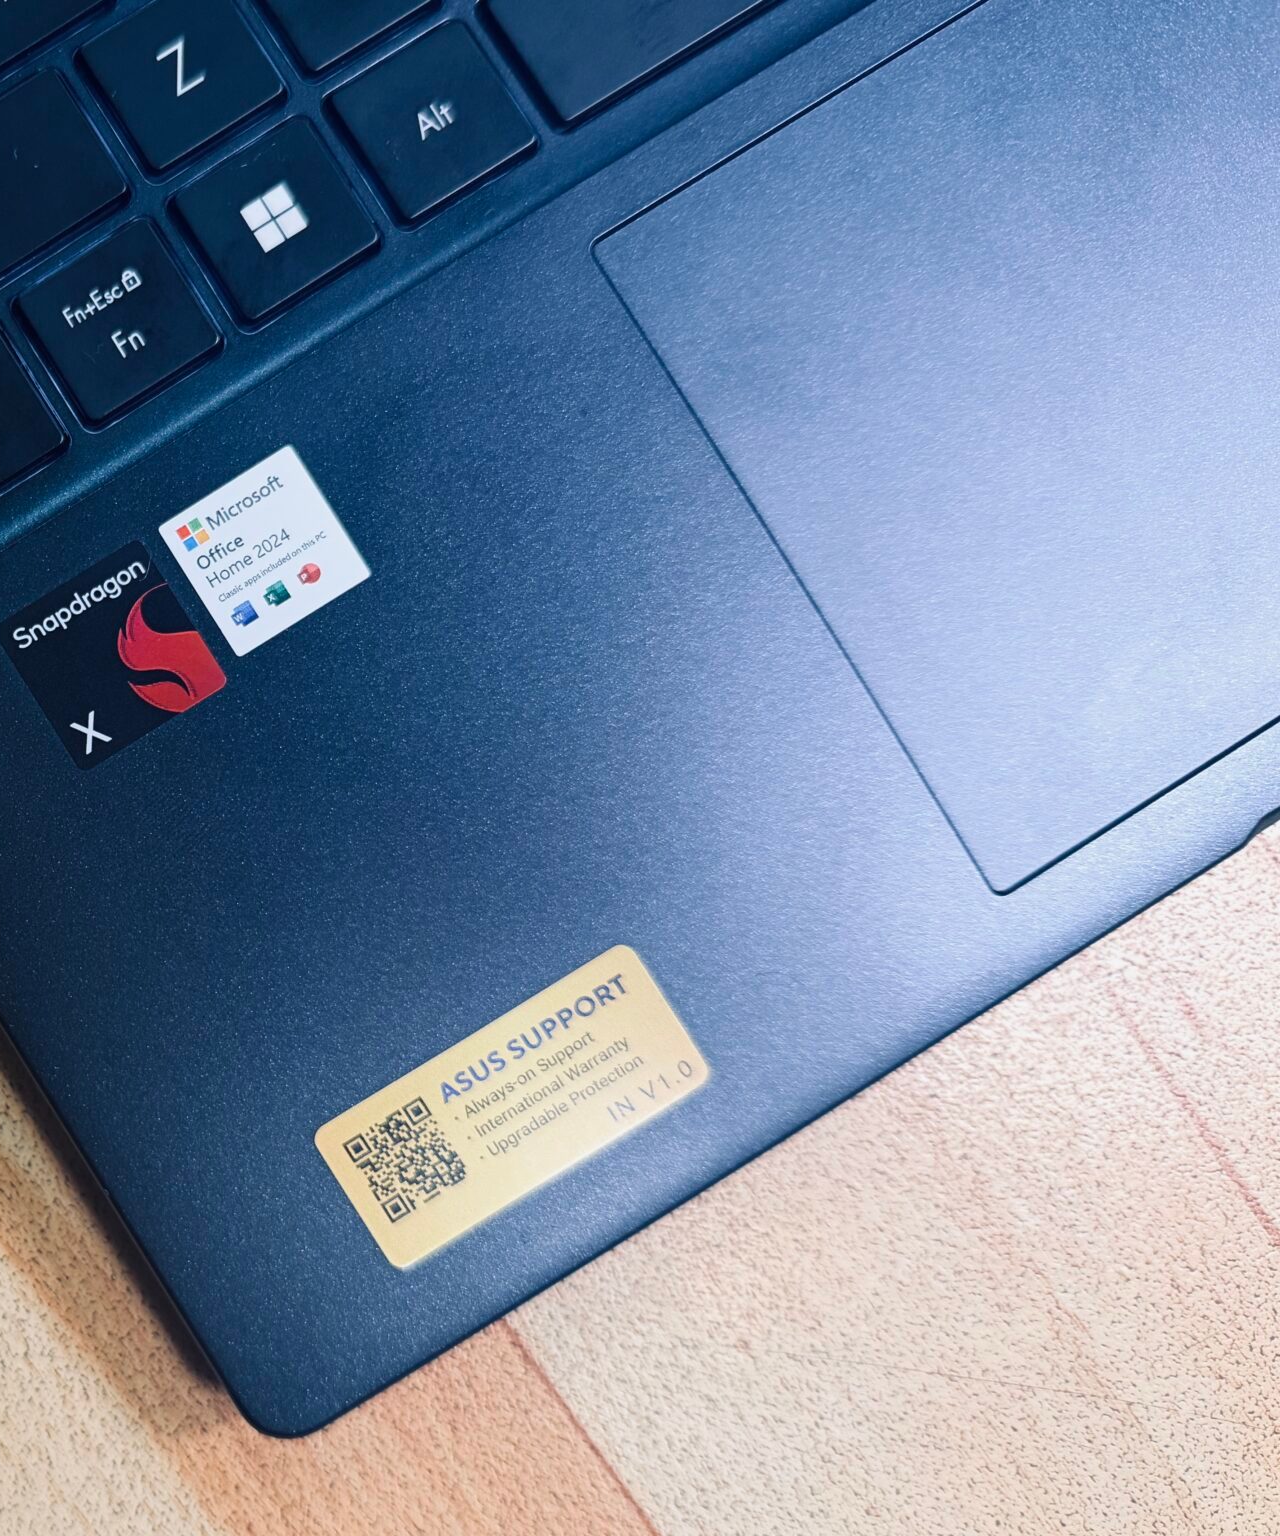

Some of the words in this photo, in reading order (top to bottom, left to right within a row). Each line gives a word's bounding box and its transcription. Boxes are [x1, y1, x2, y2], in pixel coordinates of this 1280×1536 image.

[156, 38, 205, 97] Z
[417, 101, 456, 141] Alt
[62, 289, 124, 329] Fn+Esc
[111, 331, 146, 359] Fn
[205, 475, 284, 531] Microsoft
[196, 536, 245, 570] Office
[206, 555, 253, 588] Home
[253, 528, 290, 559] 2024
[218, 585, 244, 603] Classic
[244, 573, 261, 588] apps
[260, 553, 291, 577] included
[291, 548, 301, 557] on
[301, 539, 315, 551] this
[315, 530, 327, 541] PC
[11, 559, 147, 650] Snapdragon
[69, 710, 113, 756] X
[440, 1050, 506, 1104] ASUS
[506, 973, 627, 1060] SUPPORT
[465, 1068, 537, 1119] Always-on
[536, 1031, 596, 1073] Support
[474, 1075, 565, 1138] International
[564, 1037, 630, 1081] Warranty
[606, 1094, 636, 1121] IN
[638, 1059, 693, 1100] V1.0
[486, 1101, 569, 1157] Upgradable
[568, 1055, 644, 1106] Protection
